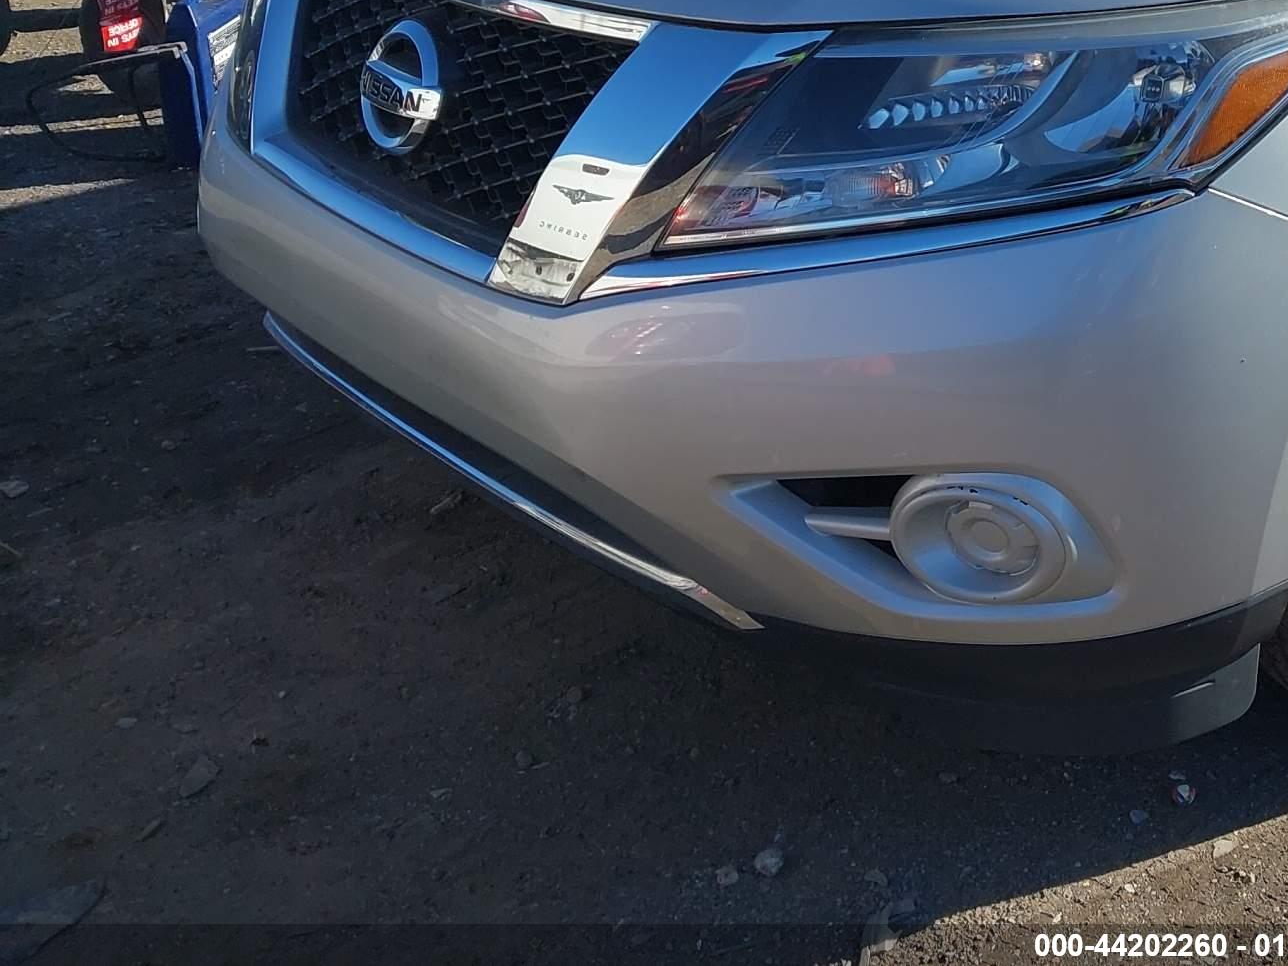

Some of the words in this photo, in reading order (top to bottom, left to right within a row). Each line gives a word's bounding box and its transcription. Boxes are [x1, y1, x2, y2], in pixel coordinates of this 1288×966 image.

[108, 18, 138, 35] OFFICE
[108, 37, 119, 47] IN
[361, 71, 423, 112] NISSAN
